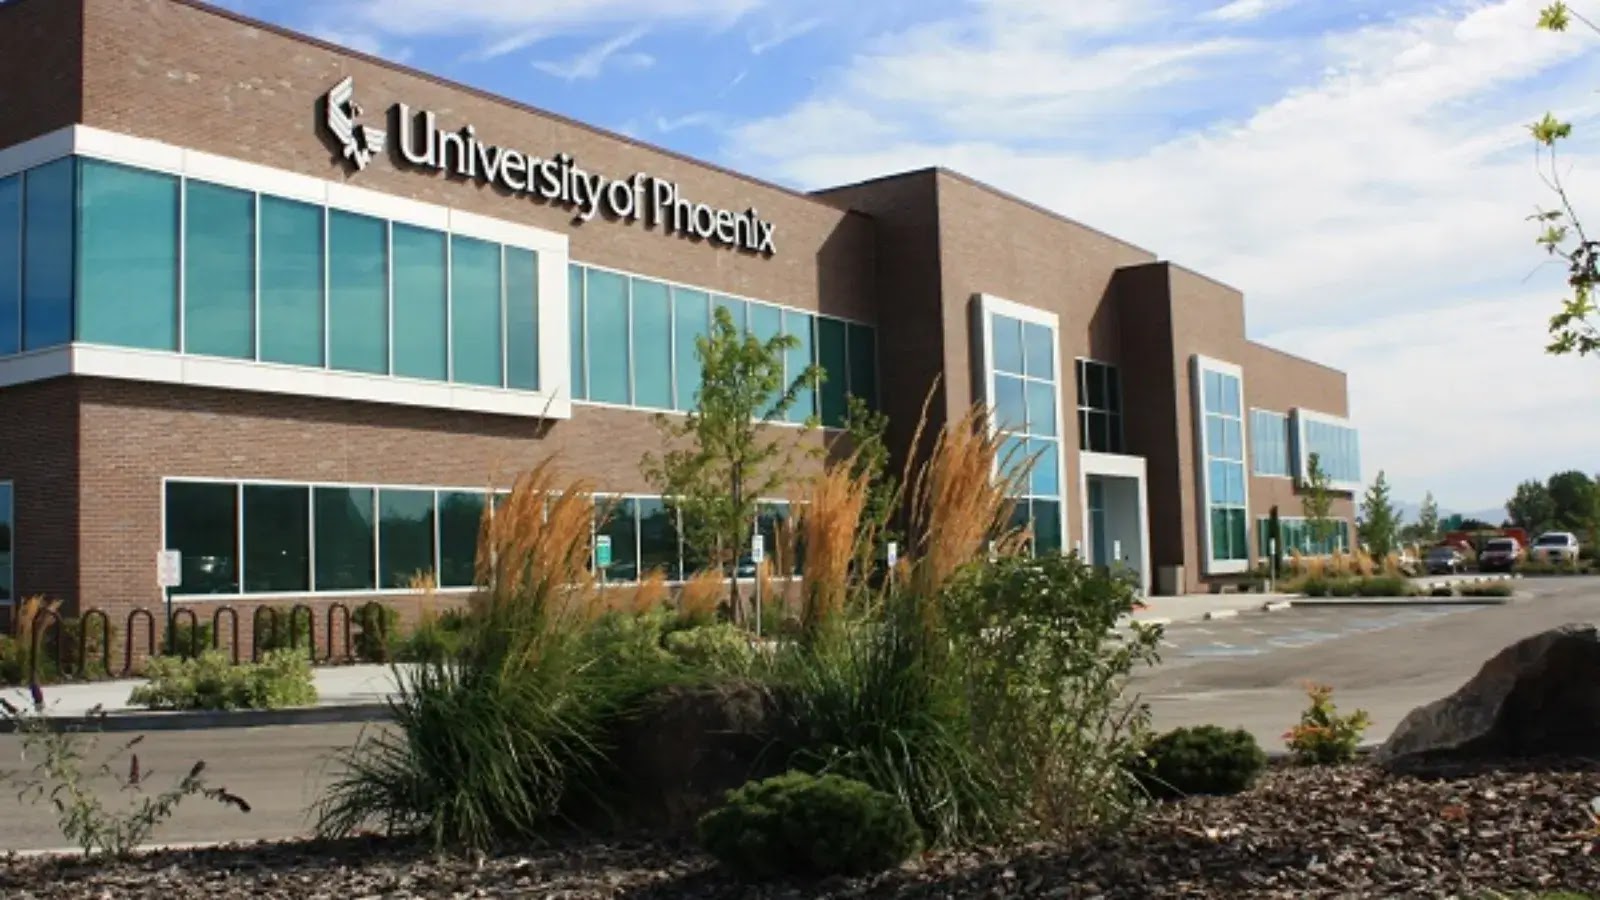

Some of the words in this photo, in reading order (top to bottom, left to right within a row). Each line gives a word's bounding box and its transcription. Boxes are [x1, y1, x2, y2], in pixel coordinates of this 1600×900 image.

[397, 103, 607, 222] University
[607, 171, 648, 219] of
[653, 178, 777, 254] Phoenix
